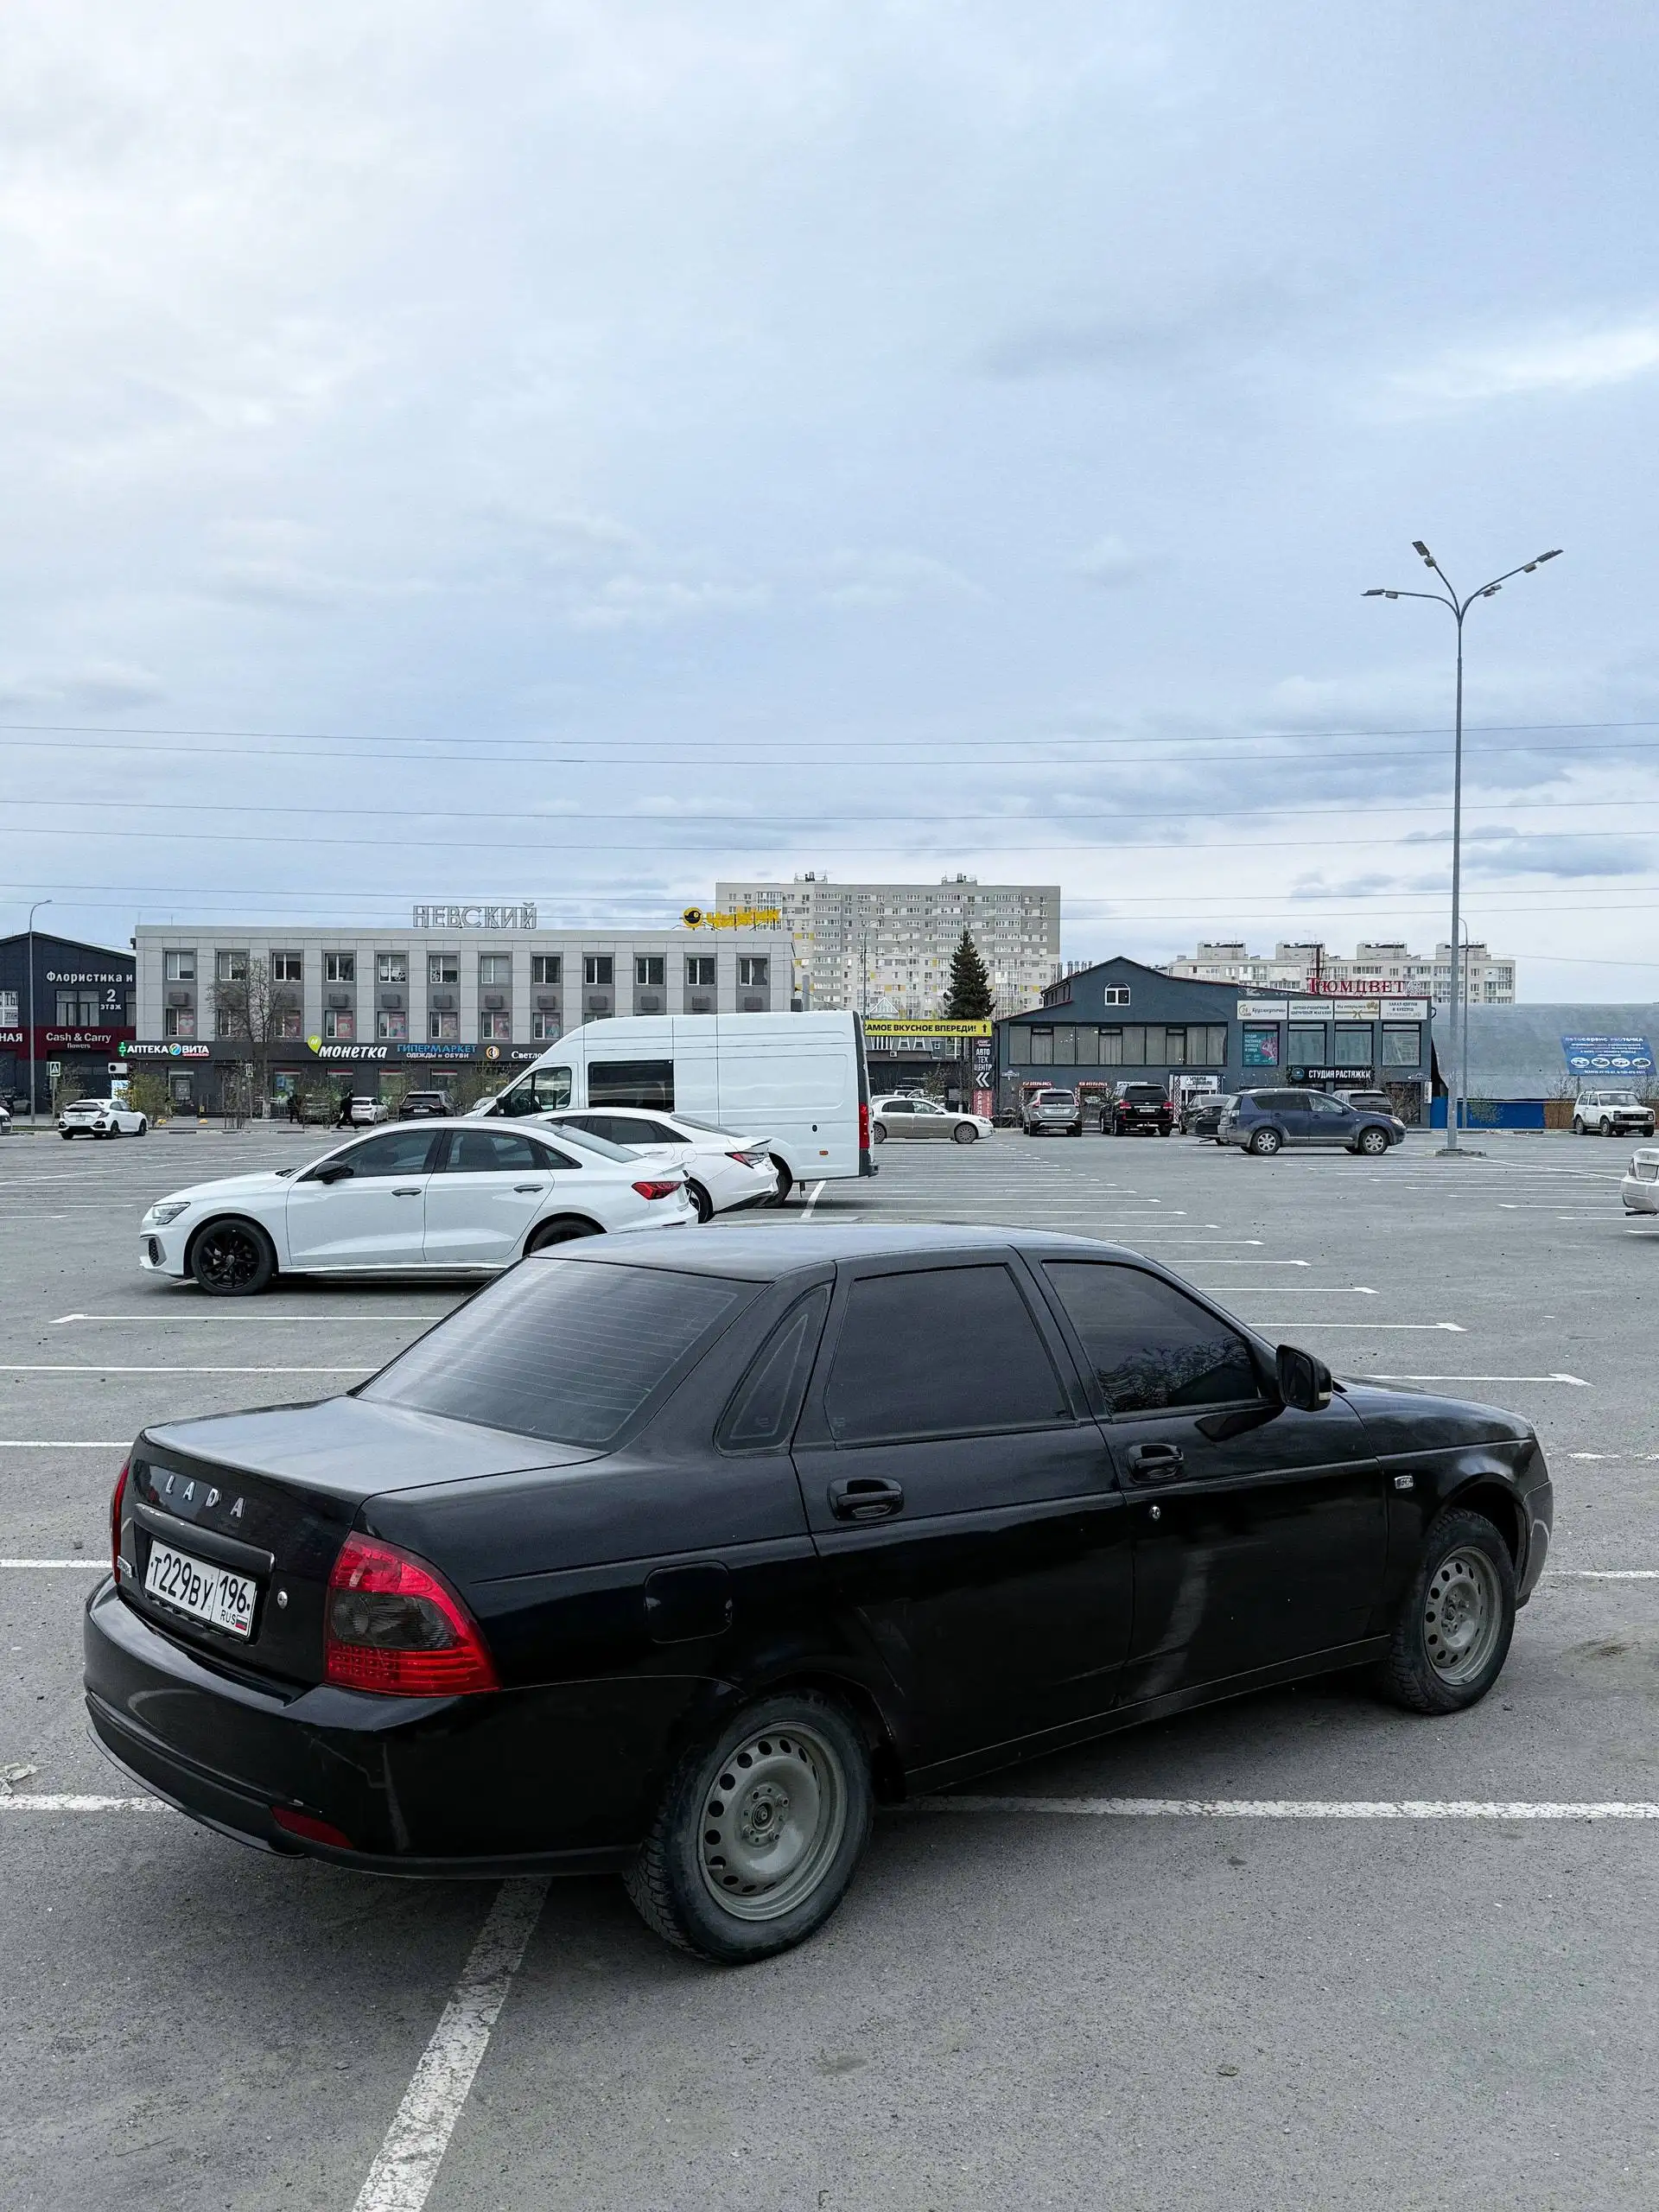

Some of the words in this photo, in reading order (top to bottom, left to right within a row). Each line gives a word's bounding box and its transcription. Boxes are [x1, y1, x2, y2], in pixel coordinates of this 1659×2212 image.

[413, 902, 537, 929] НЕВСКИЙ
[46, 971, 122, 984] Флористика
[106, 988, 117, 1002] 2
[935, 1024, 976, 1033] ВПЕРЕДИ!
[46, 1033, 72, 1042] Cash
[74, 1033, 82, 1042] &
[84, 1033, 111, 1044] Carry
[397, 1044, 477, 1053] ГИПЕРМАРКЕТ
[1308, 1070, 1335, 1079] СТУДИЯ
[1335, 1070, 1371, 1079] РАСТЯЖКИ
[166, 1475, 245, 1518] LADA
[154, 1553, 213, 1611] Т229ВУ
[220, 1575, 247, 1613] 196
[220, 1610, 236, 1625] RUS
